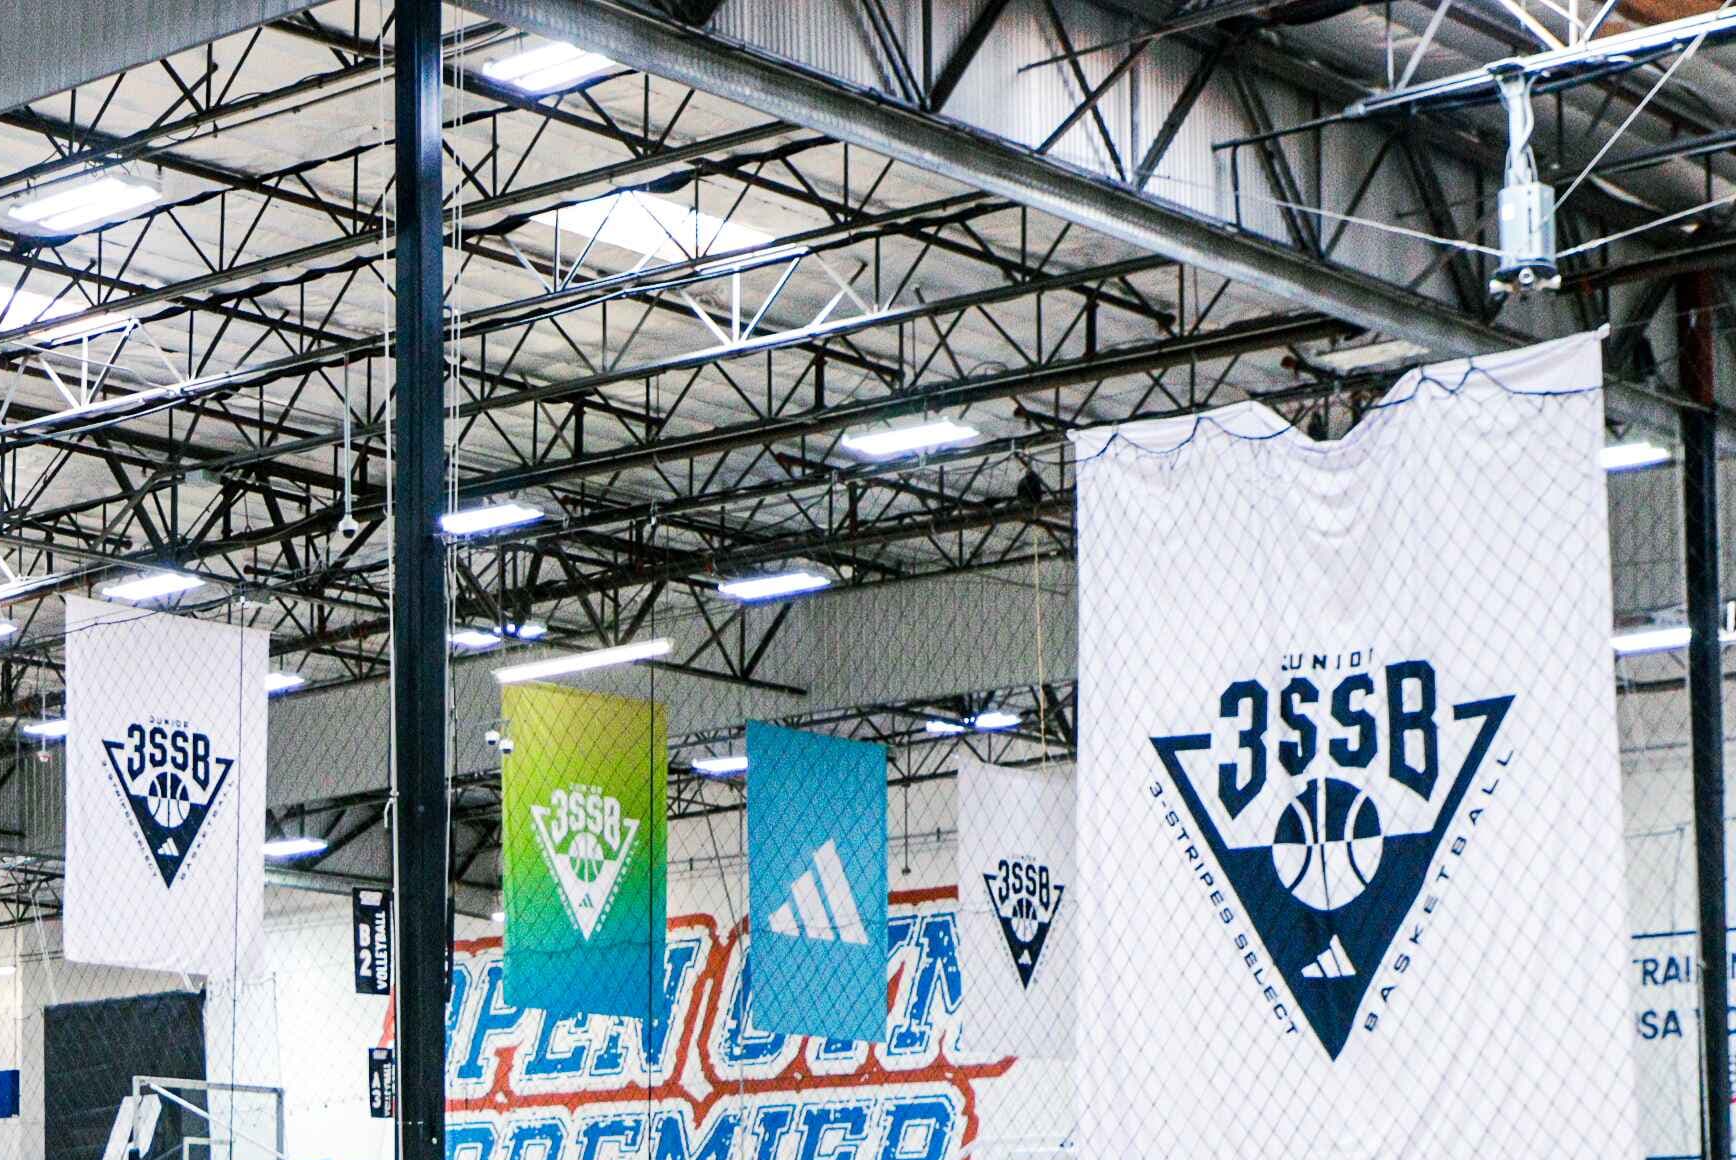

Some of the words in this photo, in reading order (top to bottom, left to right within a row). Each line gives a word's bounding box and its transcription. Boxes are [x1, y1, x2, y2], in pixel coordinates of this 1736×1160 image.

[127, 723, 211, 792] 3SSB
[1217, 660, 1439, 821] 3SSB
[550, 788, 621, 852] 3SSB
[997, 859, 1051, 913] 3SSB
[1149, 781, 1235, 925] 3-STRIPES
[1233, 932, 1299, 1036] SELECT
[1364, 748, 1514, 1033] BASKETBALL
[374, 910, 387, 991] VOLLEYBALL
